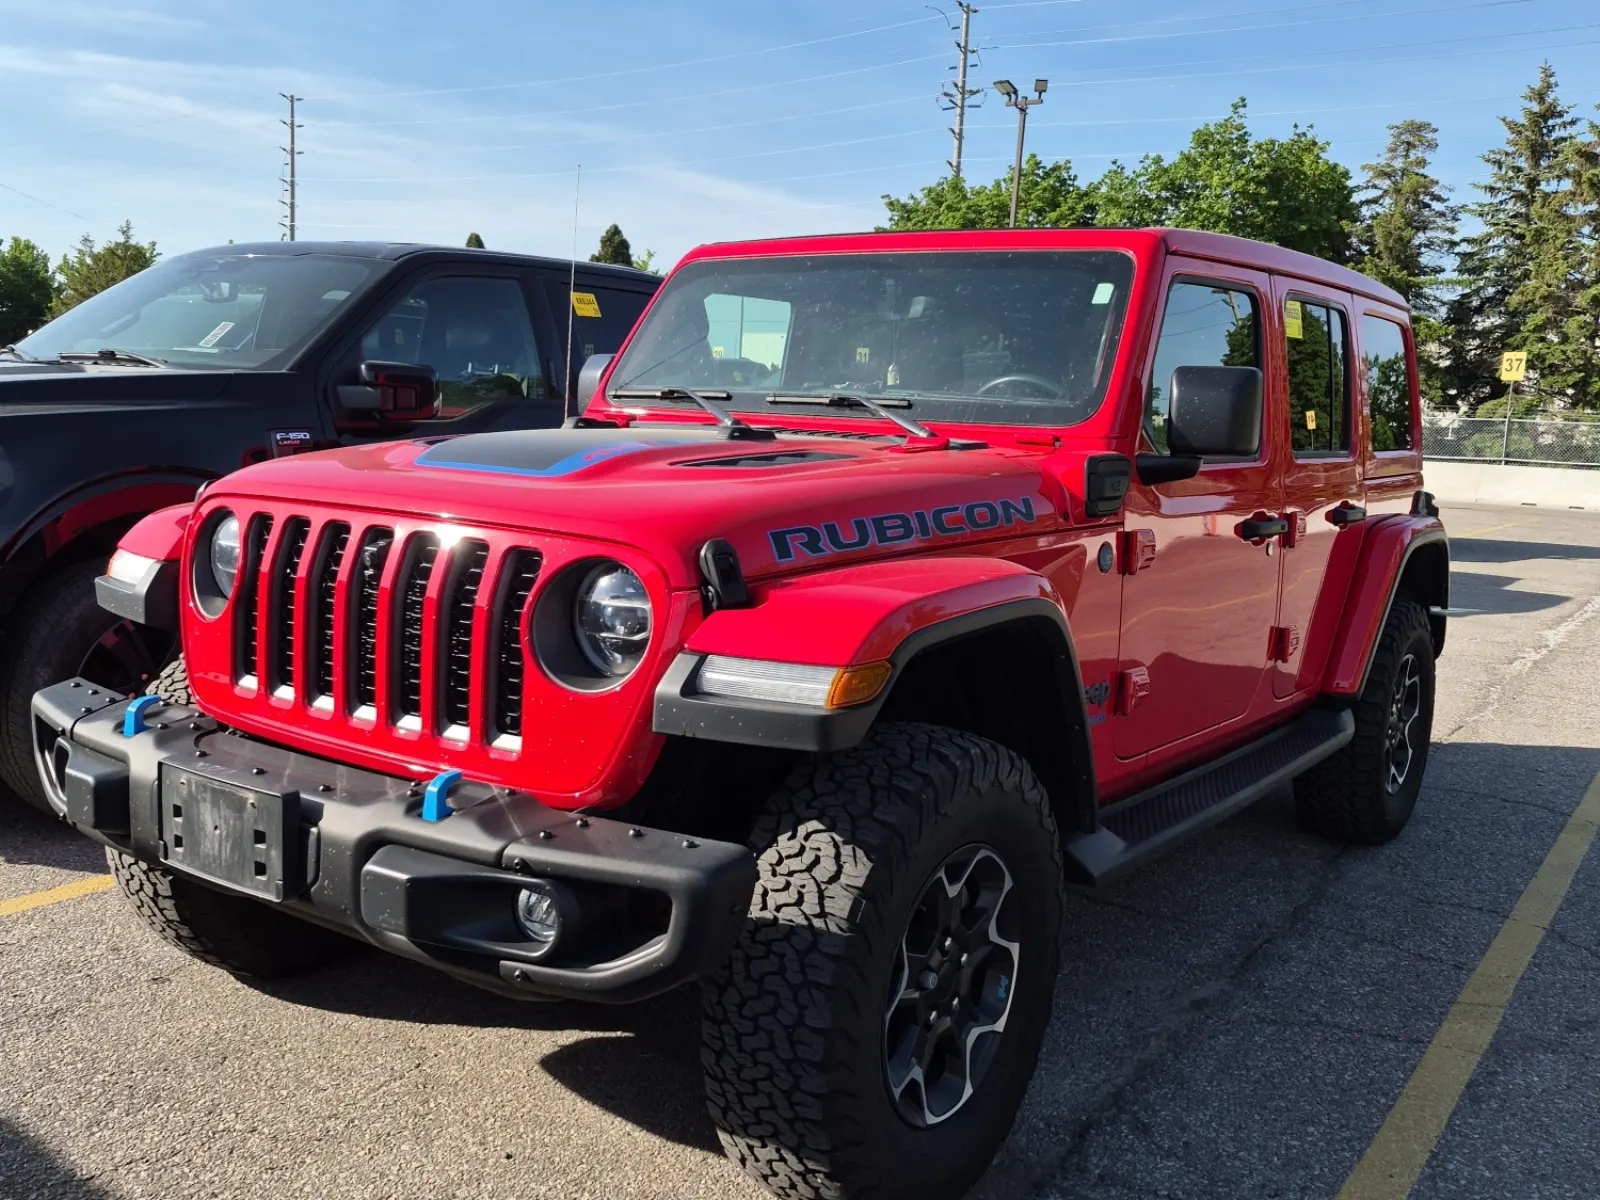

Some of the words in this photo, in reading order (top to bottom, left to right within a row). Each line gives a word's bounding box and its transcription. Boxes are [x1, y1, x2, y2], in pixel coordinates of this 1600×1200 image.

[1505, 358, 1524, 372] 37
[276, 432, 310, 440] F-150
[767, 496, 1036, 562] RUBICON
